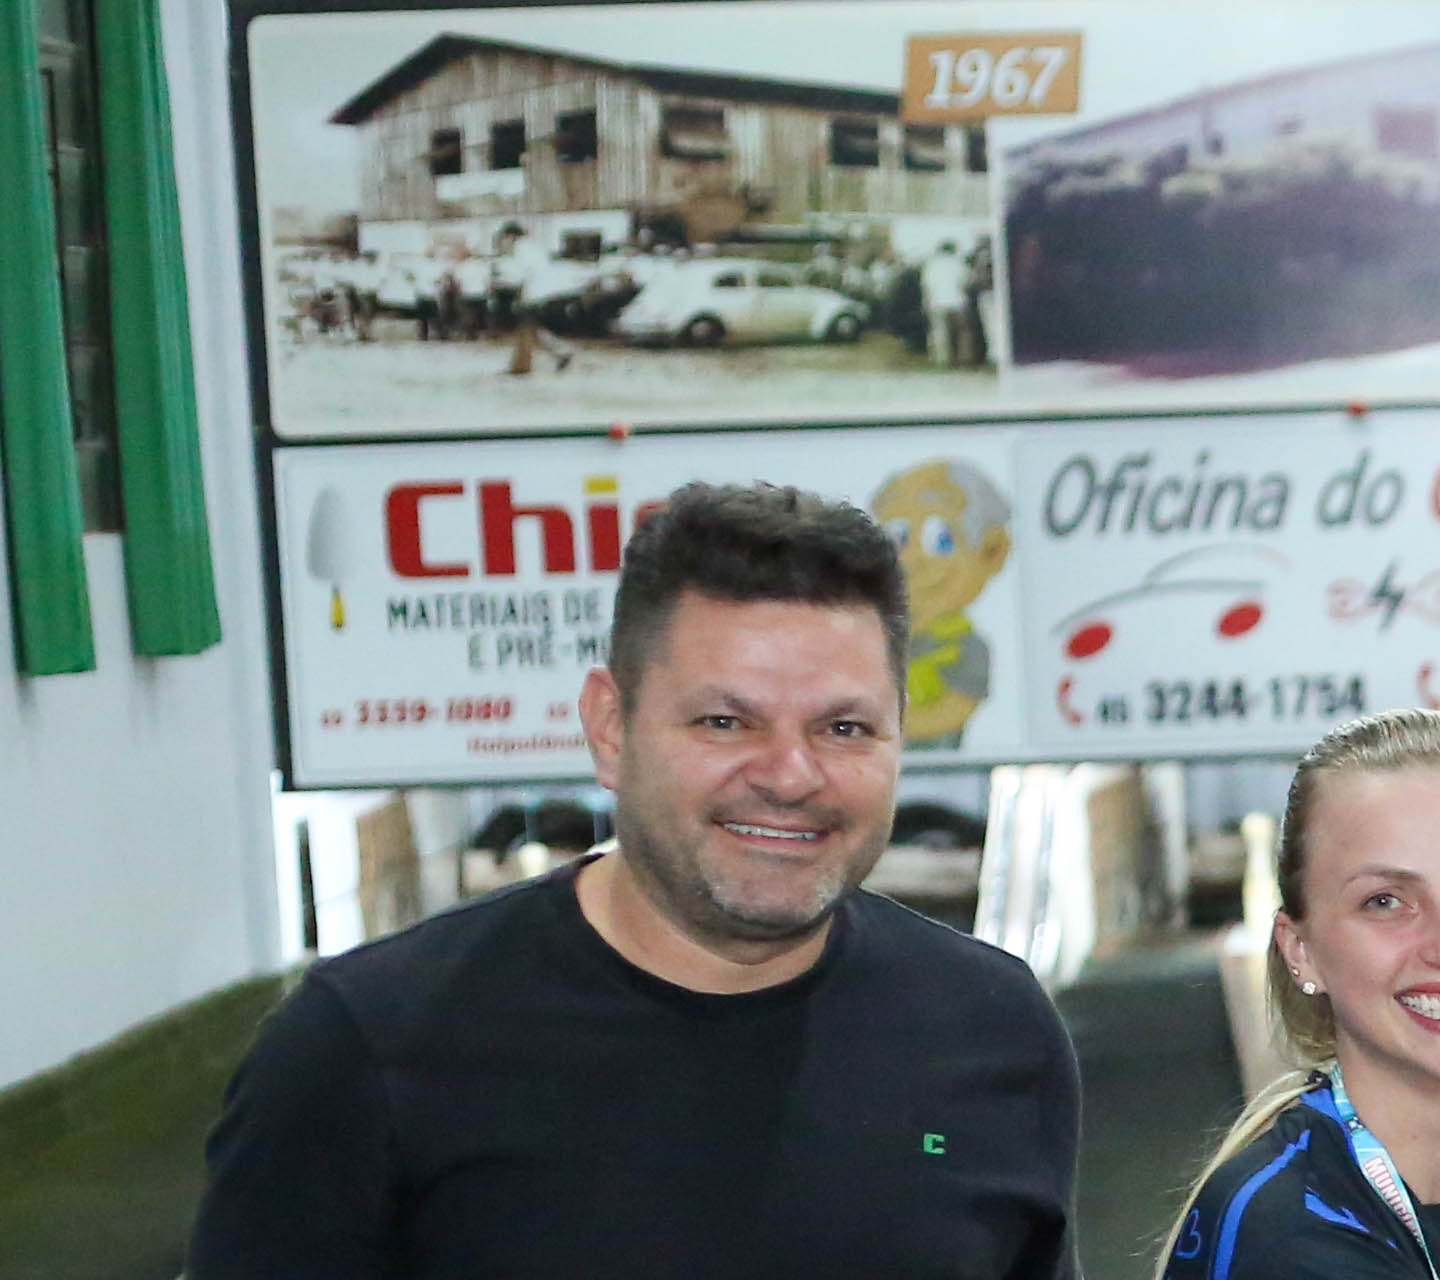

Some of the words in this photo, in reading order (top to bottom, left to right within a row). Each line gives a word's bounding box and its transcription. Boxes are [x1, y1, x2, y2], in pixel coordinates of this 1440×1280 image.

[923, 46, 1069, 109] 1967
[1043, 450, 1291, 538] Oficina
[1317, 448, 1406, 529] do
[387, 590, 551, 630] MATERIAIS
[562, 587, 604, 626] DE
[468, 635, 483, 669] E
